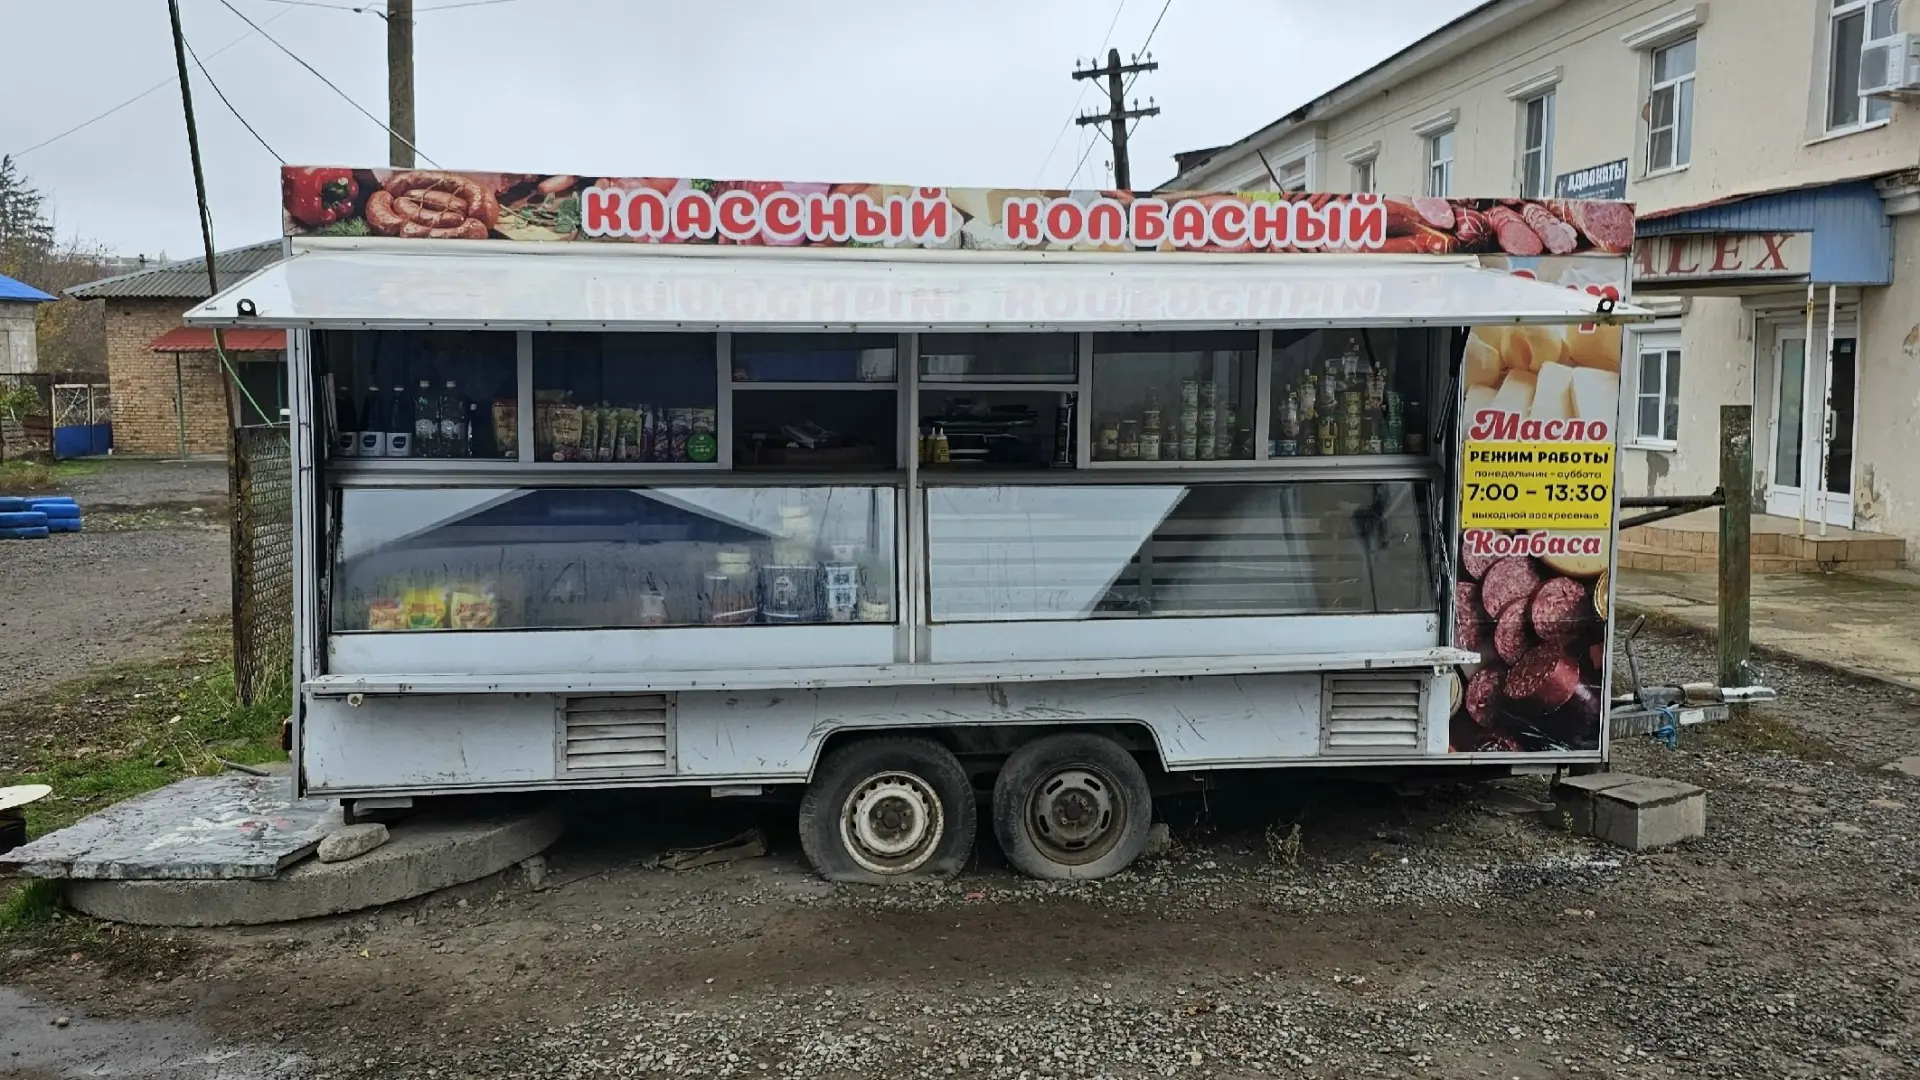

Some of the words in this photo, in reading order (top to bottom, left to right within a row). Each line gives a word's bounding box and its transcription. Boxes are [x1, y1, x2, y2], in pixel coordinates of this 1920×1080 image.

[1567, 161, 1626, 192] АДВОКАТЫ
[586, 186, 947, 238] КЛАССНЫЙ
[1006, 194, 1382, 241] КОЛБАСНЫЙ
[1470, 410, 1608, 441] Масло
[1470, 451, 1533, 464] РЕЖИМ
[1538, 452, 1609, 464] РАБОТЫ
[1466, 484, 1519, 502] 7:00
[1544, 484, 1608, 502] 13:30
[1466, 530, 1600, 554] Колбаса
